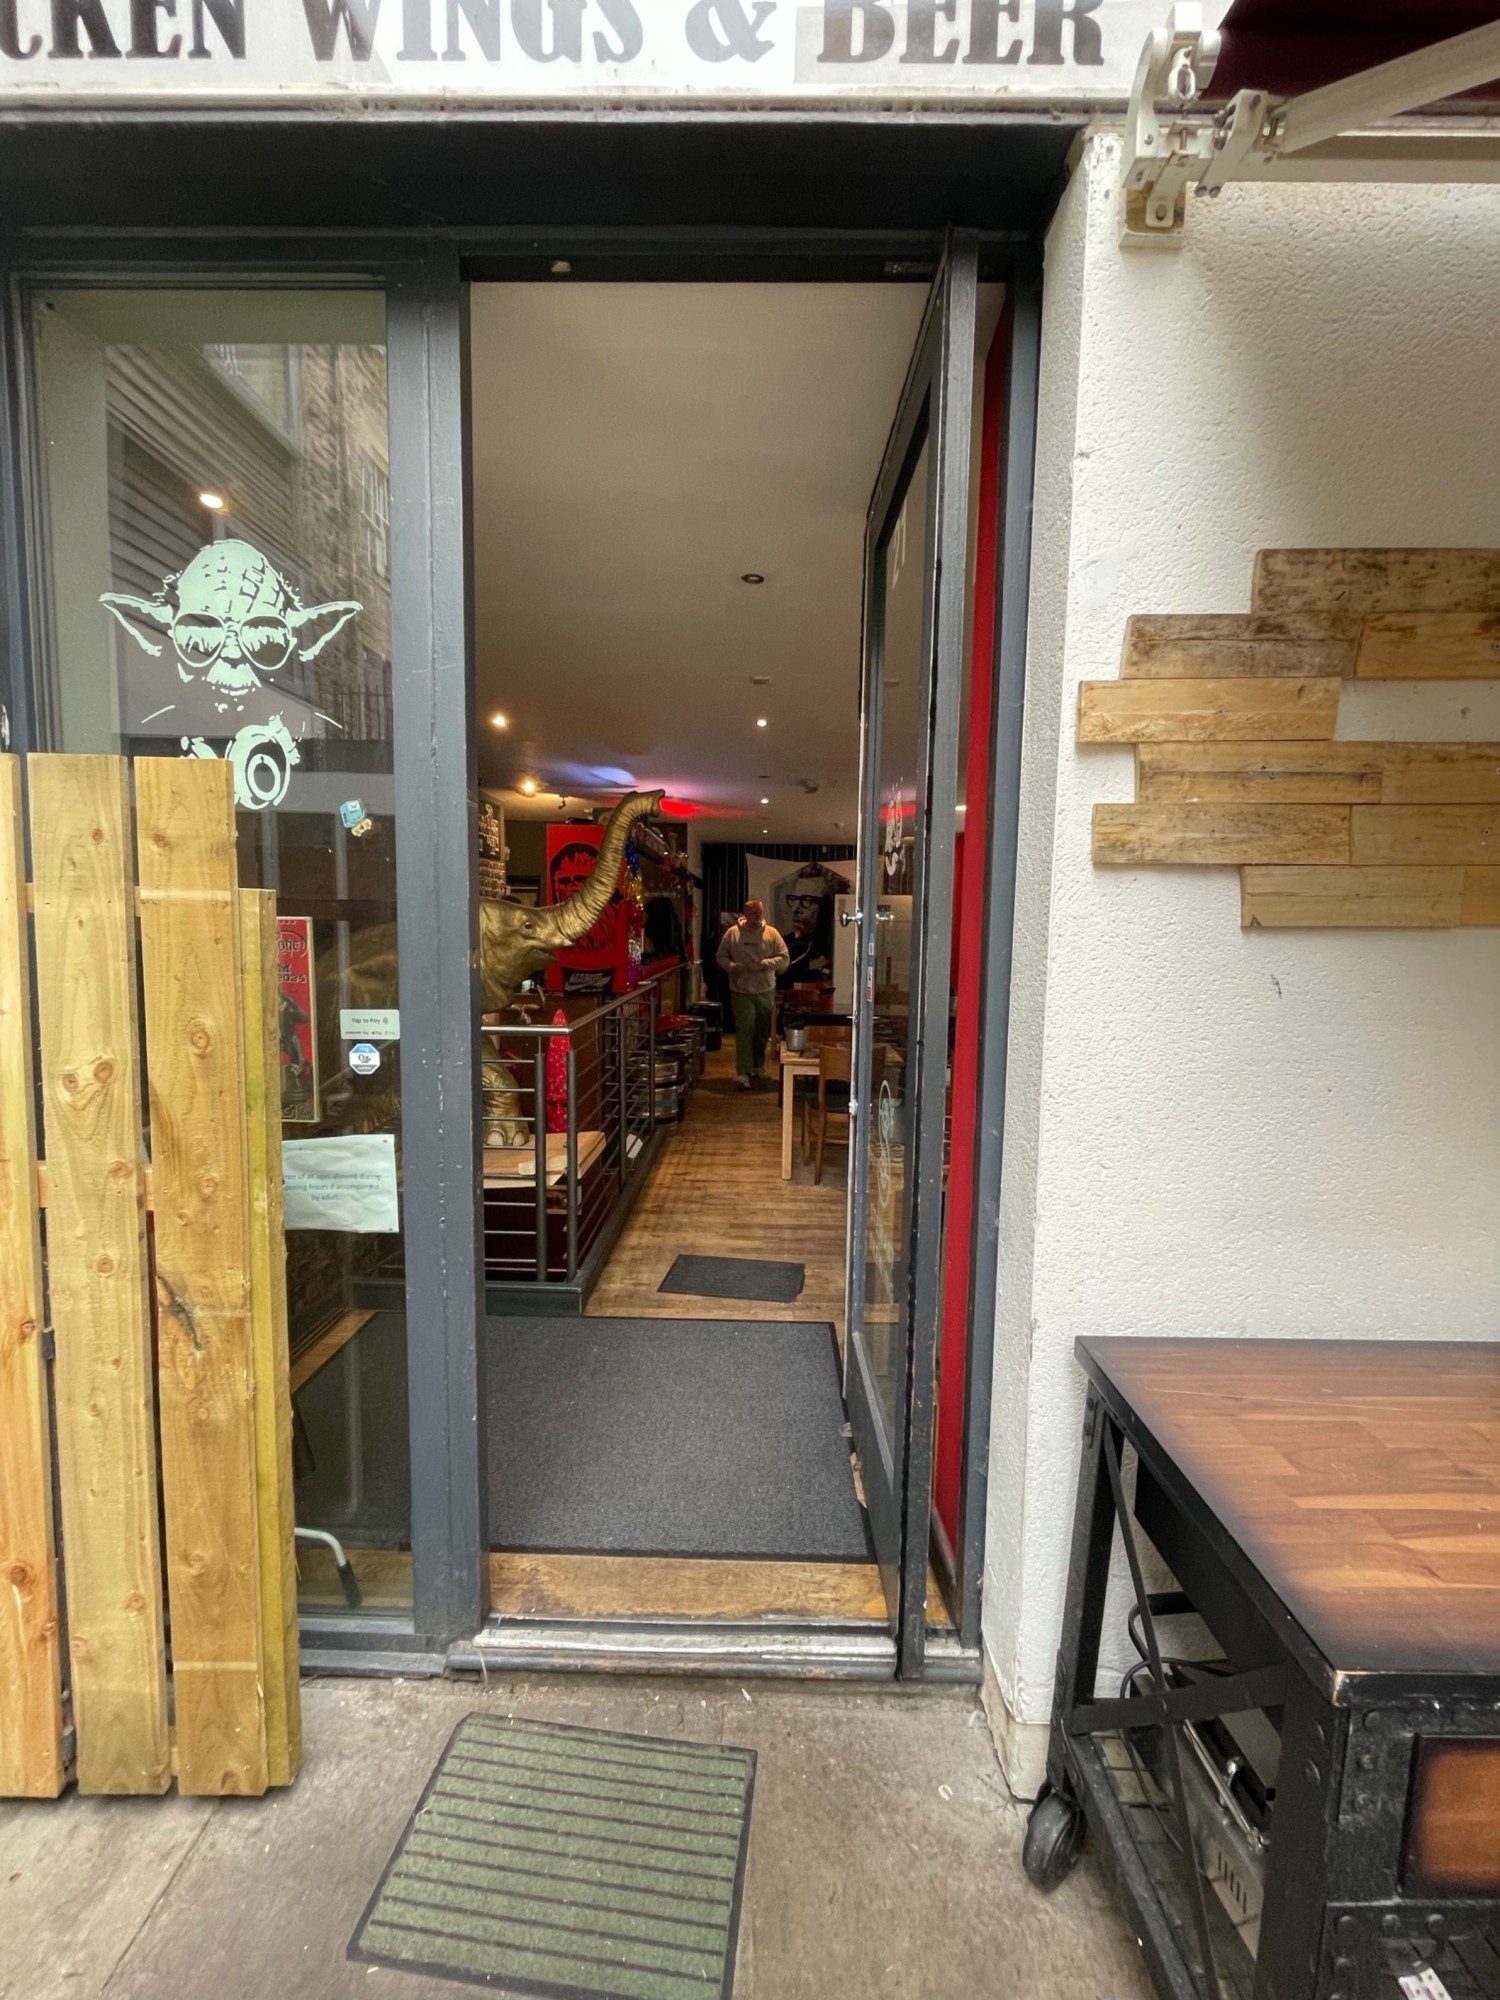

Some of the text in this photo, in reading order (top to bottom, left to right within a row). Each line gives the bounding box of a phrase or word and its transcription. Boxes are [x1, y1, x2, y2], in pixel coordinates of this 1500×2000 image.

[304, 0, 643, 62] WINGS
[685, 0, 777, 62] &
[817, 0, 1104, 65] BEER
[359, 1173, 381, 1181] during
